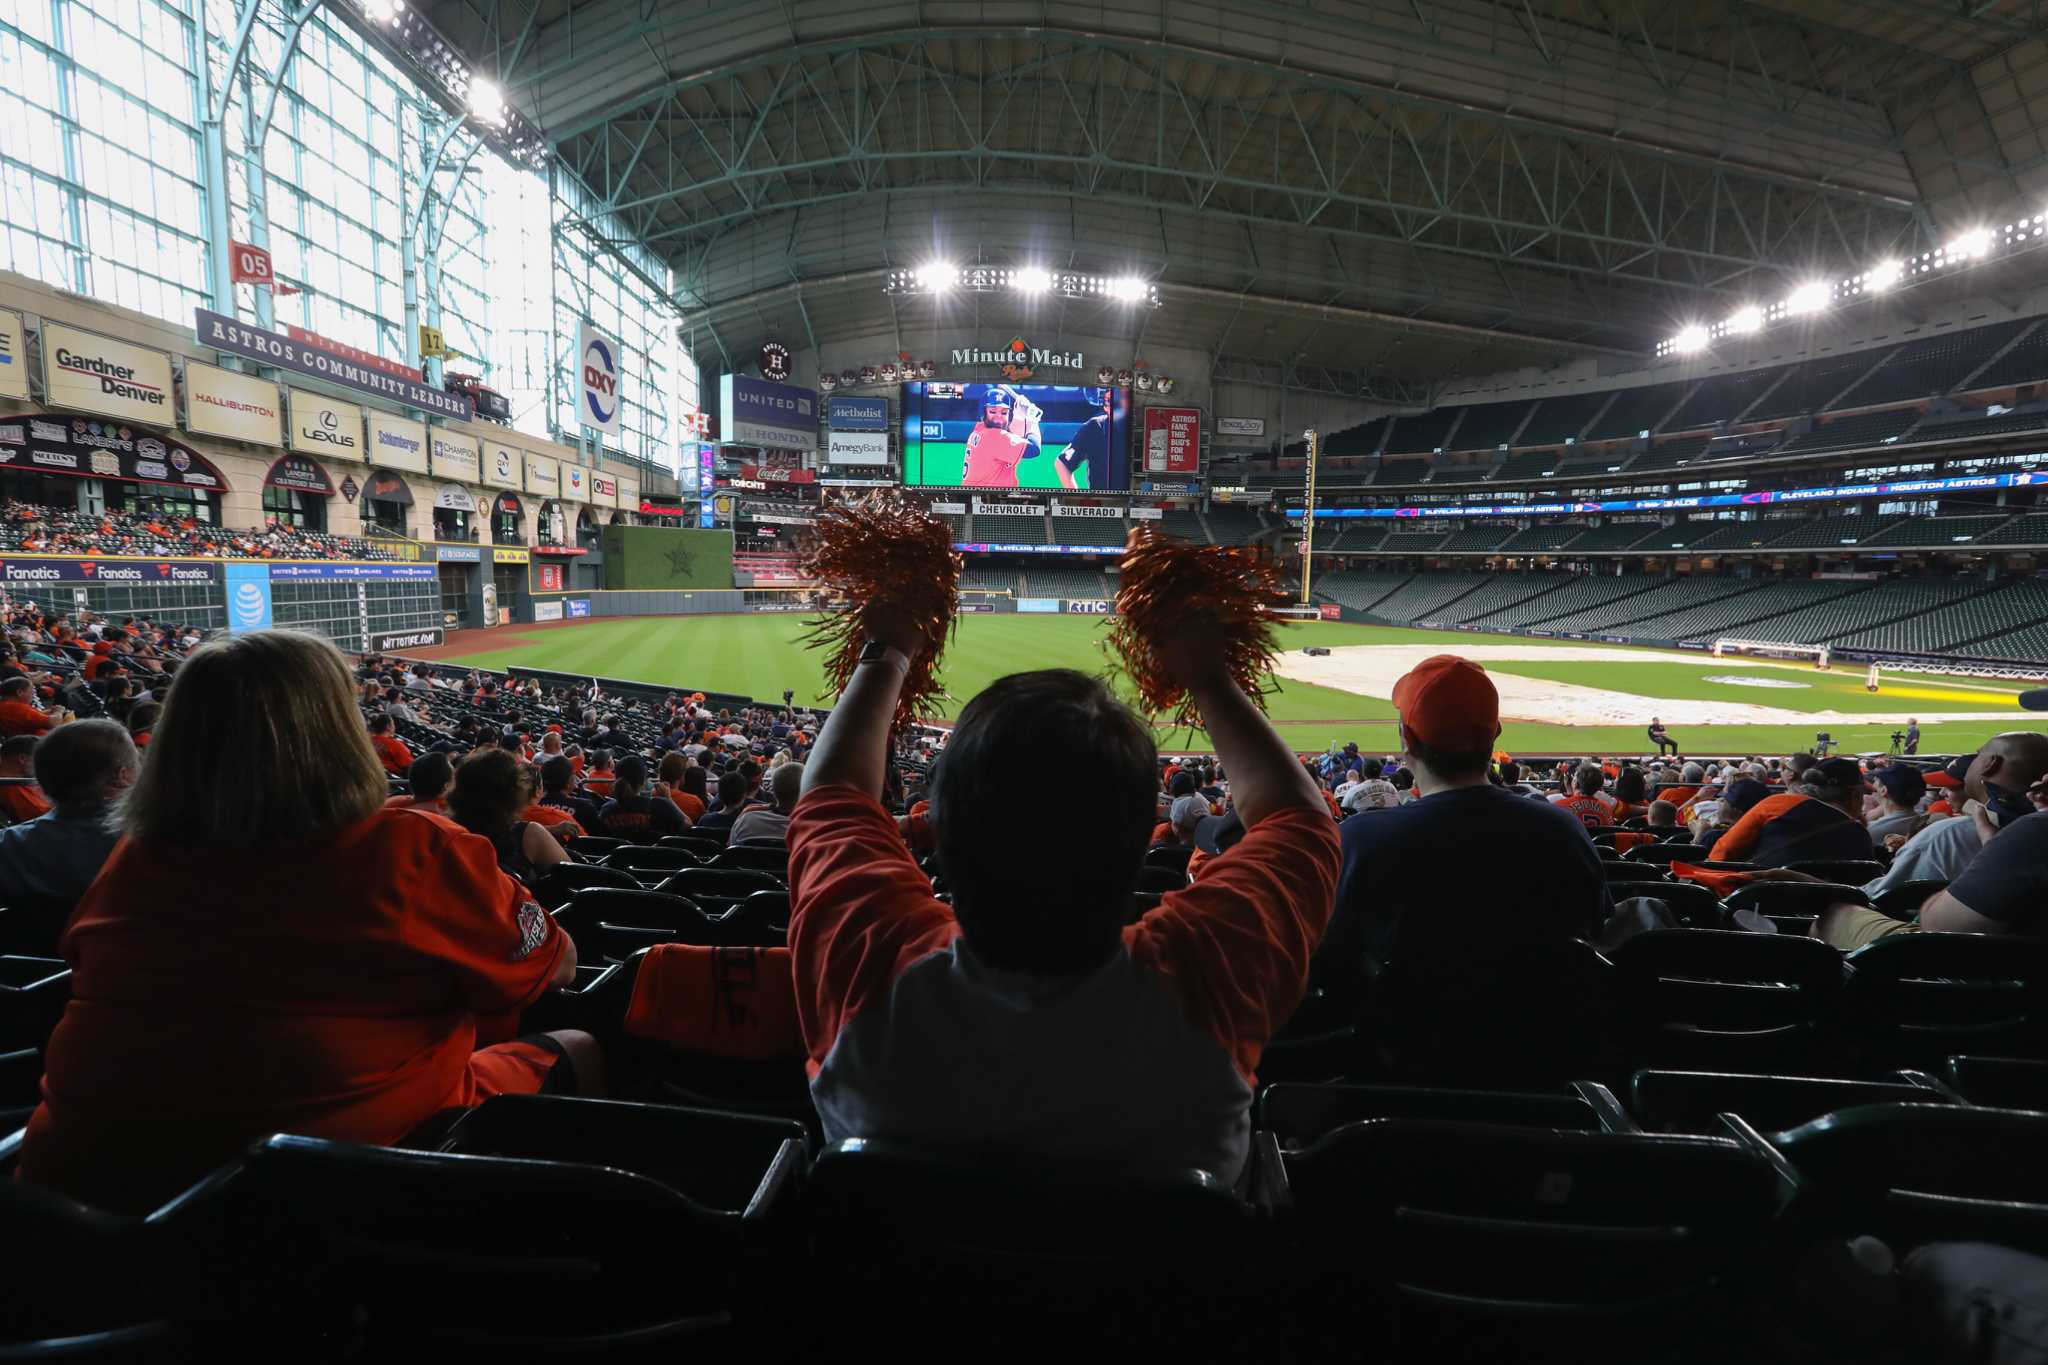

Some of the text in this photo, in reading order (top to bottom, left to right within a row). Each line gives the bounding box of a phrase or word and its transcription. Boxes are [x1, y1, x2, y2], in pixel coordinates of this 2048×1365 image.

[241, 252, 268, 276] 05
[425, 332, 441, 350] 17
[55, 347, 135, 381] Gardner
[770, 354, 783, 369] H
[951, 348, 1083, 369] Minute Maid
[211, 321, 298, 361] ASTROS
[303, 351, 405, 397] COMMUNITY
[411, 387, 466, 416] LEADERS
[584, 366, 617, 397] OXY
[101, 376, 165, 405] Denver
[194, 392, 275, 418] HALLIBURTON
[738, 391, 795, 409] UNITED
[1171, 415, 1196, 423] ASTROS
[1171, 423, 1189, 431] FANS,
[302, 427, 354, 447] LEXUS
[755, 431, 809, 446] HONDA
[1171, 431, 1186, 439] THIS
[443, 441, 477, 459] CHAMPION
[831, 441, 884, 455] AmegyBank
[1170, 439, 1190, 447] BUD'S
[756, 466, 791, 481] Coca-Cola
[1781, 477, 1997, 500] CLEVELAND INDIANS HOUSTON ASTROS
[979, 505, 1038, 515] CHEVROLET
[1060, 507, 1116, 517] SILVERADO
[6, 565, 60, 580] Fanatics
[97, 566, 142, 580] Fanatics
[171, 567, 208, 579] Fanatics
[1069, 601, 1107, 612] RTIC
[382, 633, 435, 650] NITTOTIRE.COM
